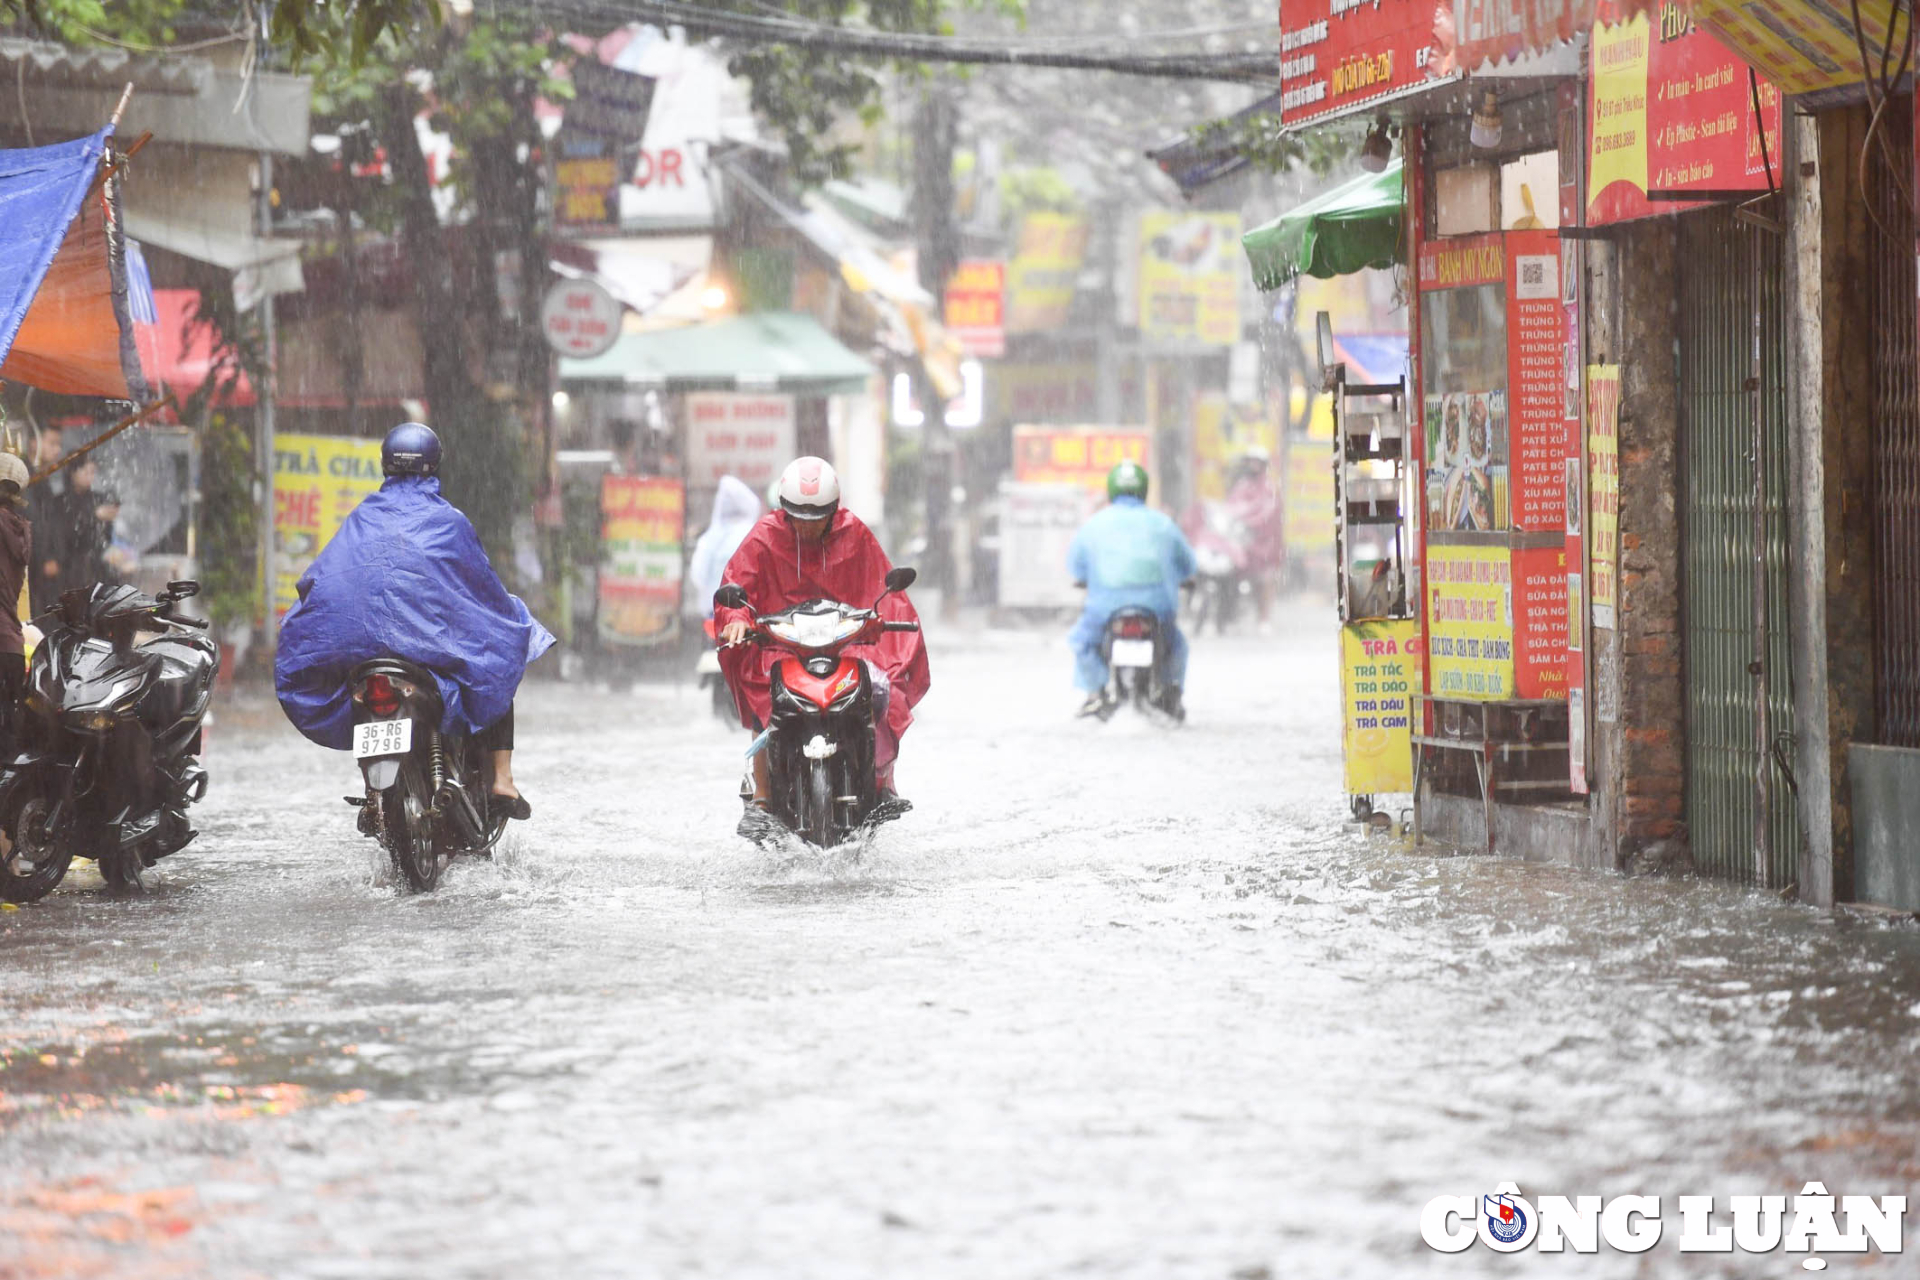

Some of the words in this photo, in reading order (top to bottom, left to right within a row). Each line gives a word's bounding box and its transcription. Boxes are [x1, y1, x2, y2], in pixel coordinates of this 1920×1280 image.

[1667, 79, 1674, 100] In
[1695, 72, 1703, 93] In
[1704, 66, 1719, 90] card
[1701, 118, 1716, 138] Scan
[1522, 422, 1547, 432] PATE
[1549, 422, 1562, 431] TH
[1522, 435, 1547, 445] PATE
[1522, 448, 1547, 459] PATE
[1549, 448, 1564, 458] CH
[328, 455, 384, 482] CHA
[1523, 461, 1548, 471] PATE
[1550, 606, 1567, 616] NG
[1527, 621, 1548, 632] TRÀ
[1362, 636, 1398, 655] TRÀ
[1354, 662, 1377, 677] TRÀ
[1354, 679, 1377, 693] TRÀ
[1355, 697, 1377, 711] TRÀ
[1355, 715, 1378, 729] TRÀ
[1382, 716, 1407, 728] CAM
[362, 722, 403, 739] 36-R6
[361, 737, 402, 754] 9796
